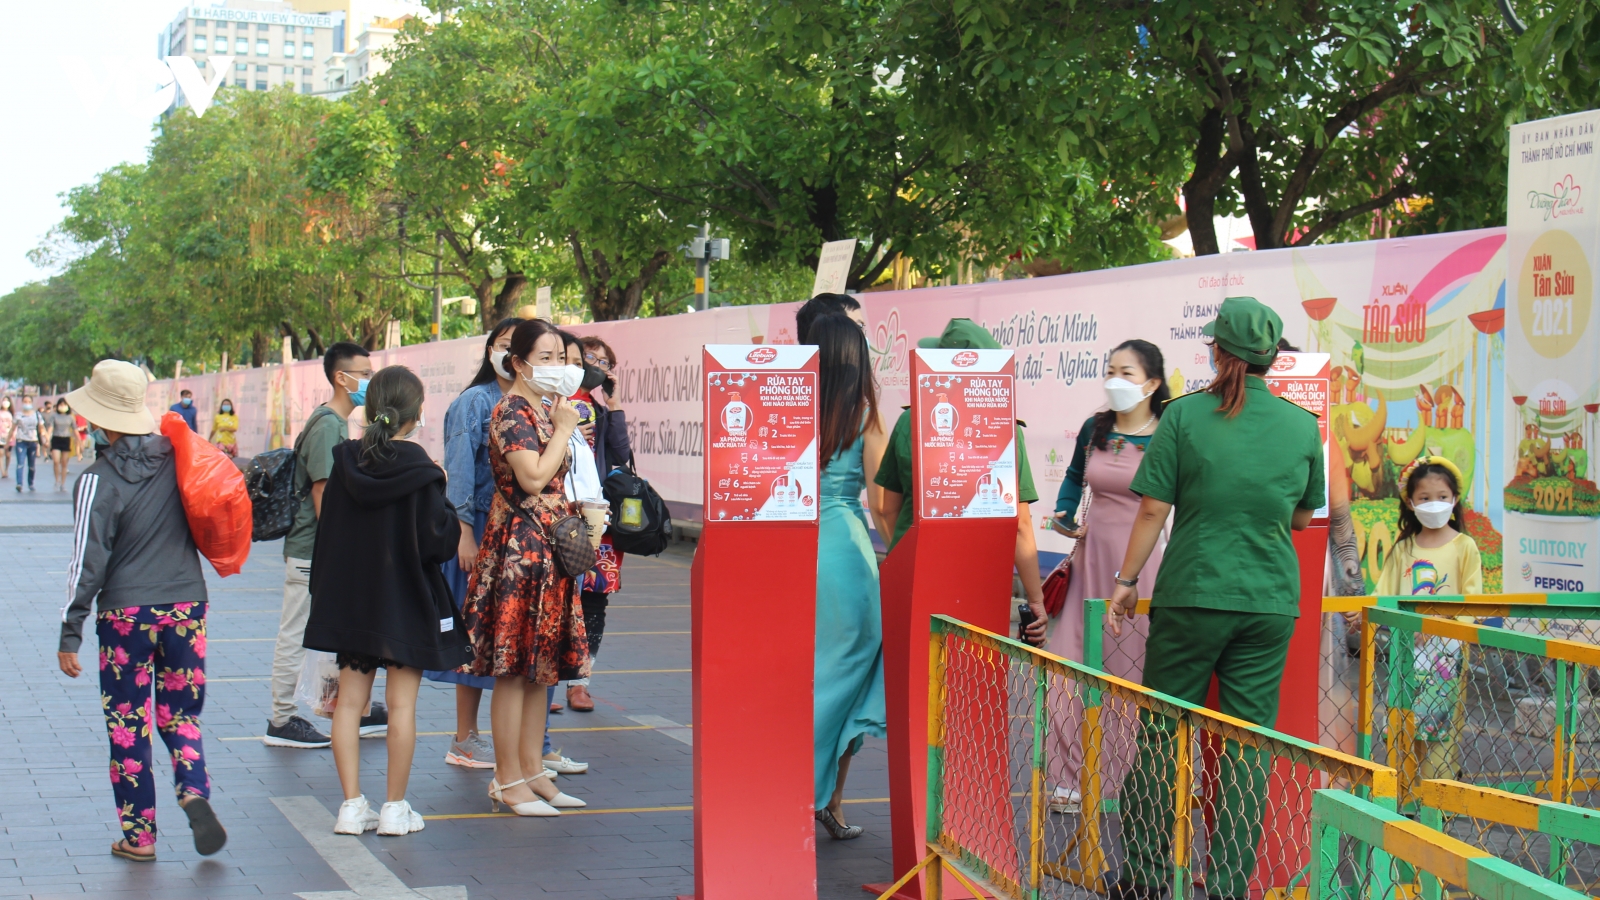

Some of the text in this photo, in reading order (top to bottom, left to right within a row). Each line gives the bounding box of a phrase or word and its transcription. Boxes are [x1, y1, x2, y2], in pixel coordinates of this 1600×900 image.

[204, 9, 331, 26] HARBOUR VIEW TOWER
[1535, 131, 1549, 142] BAN
[1554, 126, 1573, 139] NHÂN
[1579, 122, 1594, 136] DÂN
[1522, 141, 1593, 164] THÀNH PHỐ HỒ CHÍ MINH
[1533, 253, 1552, 271] XUÂN
[1533, 270, 1575, 297] Tân Sửu
[1382, 282, 1408, 296] XUÂN
[1183, 301, 1195, 318] ỦY
[1196, 304, 1212, 317] BAN
[1532, 298, 1573, 336] 2021
[1017, 310, 1035, 347] Hồ
[1038, 314, 1060, 344] Chí
[1062, 313, 1097, 343] Minh
[1170, 323, 1196, 340] THÀNH
[749, 352, 776, 360] Lifebuoy
[1022, 351, 1044, 387] đại
[1057, 351, 1098, 386] Nghĩa
[636, 358, 671, 403] MỪNG
[672, 356, 701, 402] NĂM
[767, 374, 805, 386] RỬA TAY
[970, 377, 1003, 388] RỬA TAY
[759, 385, 812, 396] PHÒNG DỊCH
[1287, 381, 1319, 391] RỬA TAY
[964, 387, 1009, 397] PHÒNG DỊCH
[1308, 391, 1326, 401] DỊCH
[781, 416, 787, 425] 1
[983, 417, 988, 425] 1
[640, 422, 656, 455] Tân
[657, 419, 678, 455] Sửu
[678, 421, 704, 457] 2021
[771, 429, 778, 438] 2
[975, 429, 981, 438] 2
[762, 441, 768, 450] 3
[967, 441, 973, 449] 3
[752, 453, 758, 462] 4
[958, 453, 964, 461] 4
[743, 466, 749, 475] 5
[951, 465, 956, 474] 5
[733, 479, 739, 488] 6
[943, 477, 949, 486] 6
[724, 492, 730, 501] 7
[935, 490, 941, 499] 7
[1533, 485, 1573, 512] 2021
[1534, 576, 1584, 593] PEPSICO
